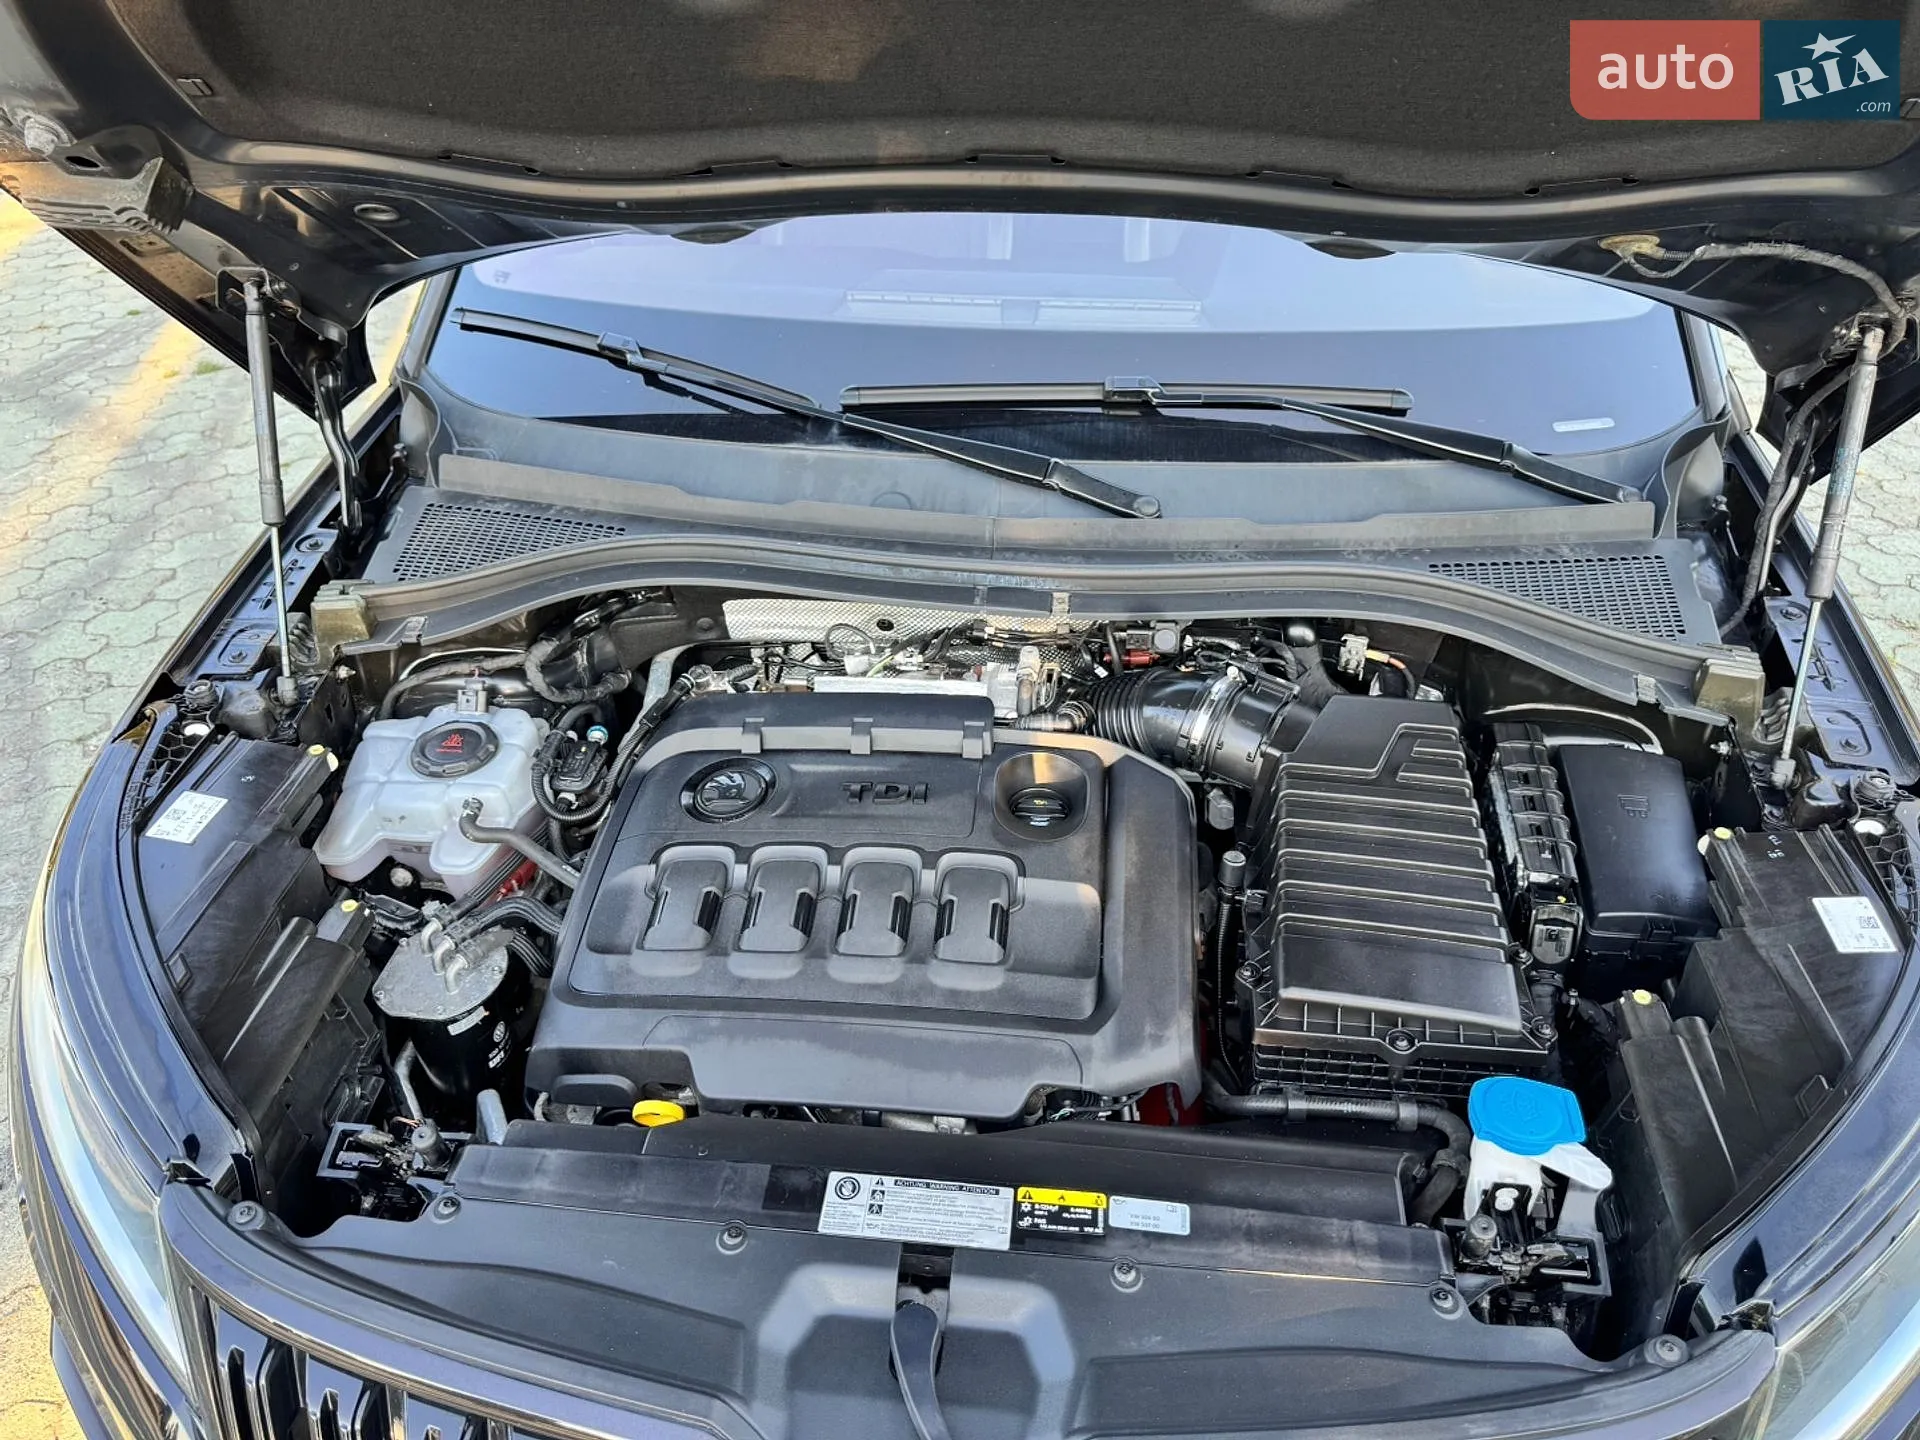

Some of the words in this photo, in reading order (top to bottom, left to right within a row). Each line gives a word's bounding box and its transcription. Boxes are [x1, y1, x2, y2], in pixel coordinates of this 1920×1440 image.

[842, 782, 928, 805] TDI
[895, 1180, 927, 1189] ACHTUNG
[930, 1182, 960, 1192] WARNING
[962, 1186, 996, 1195] ATTENTION
